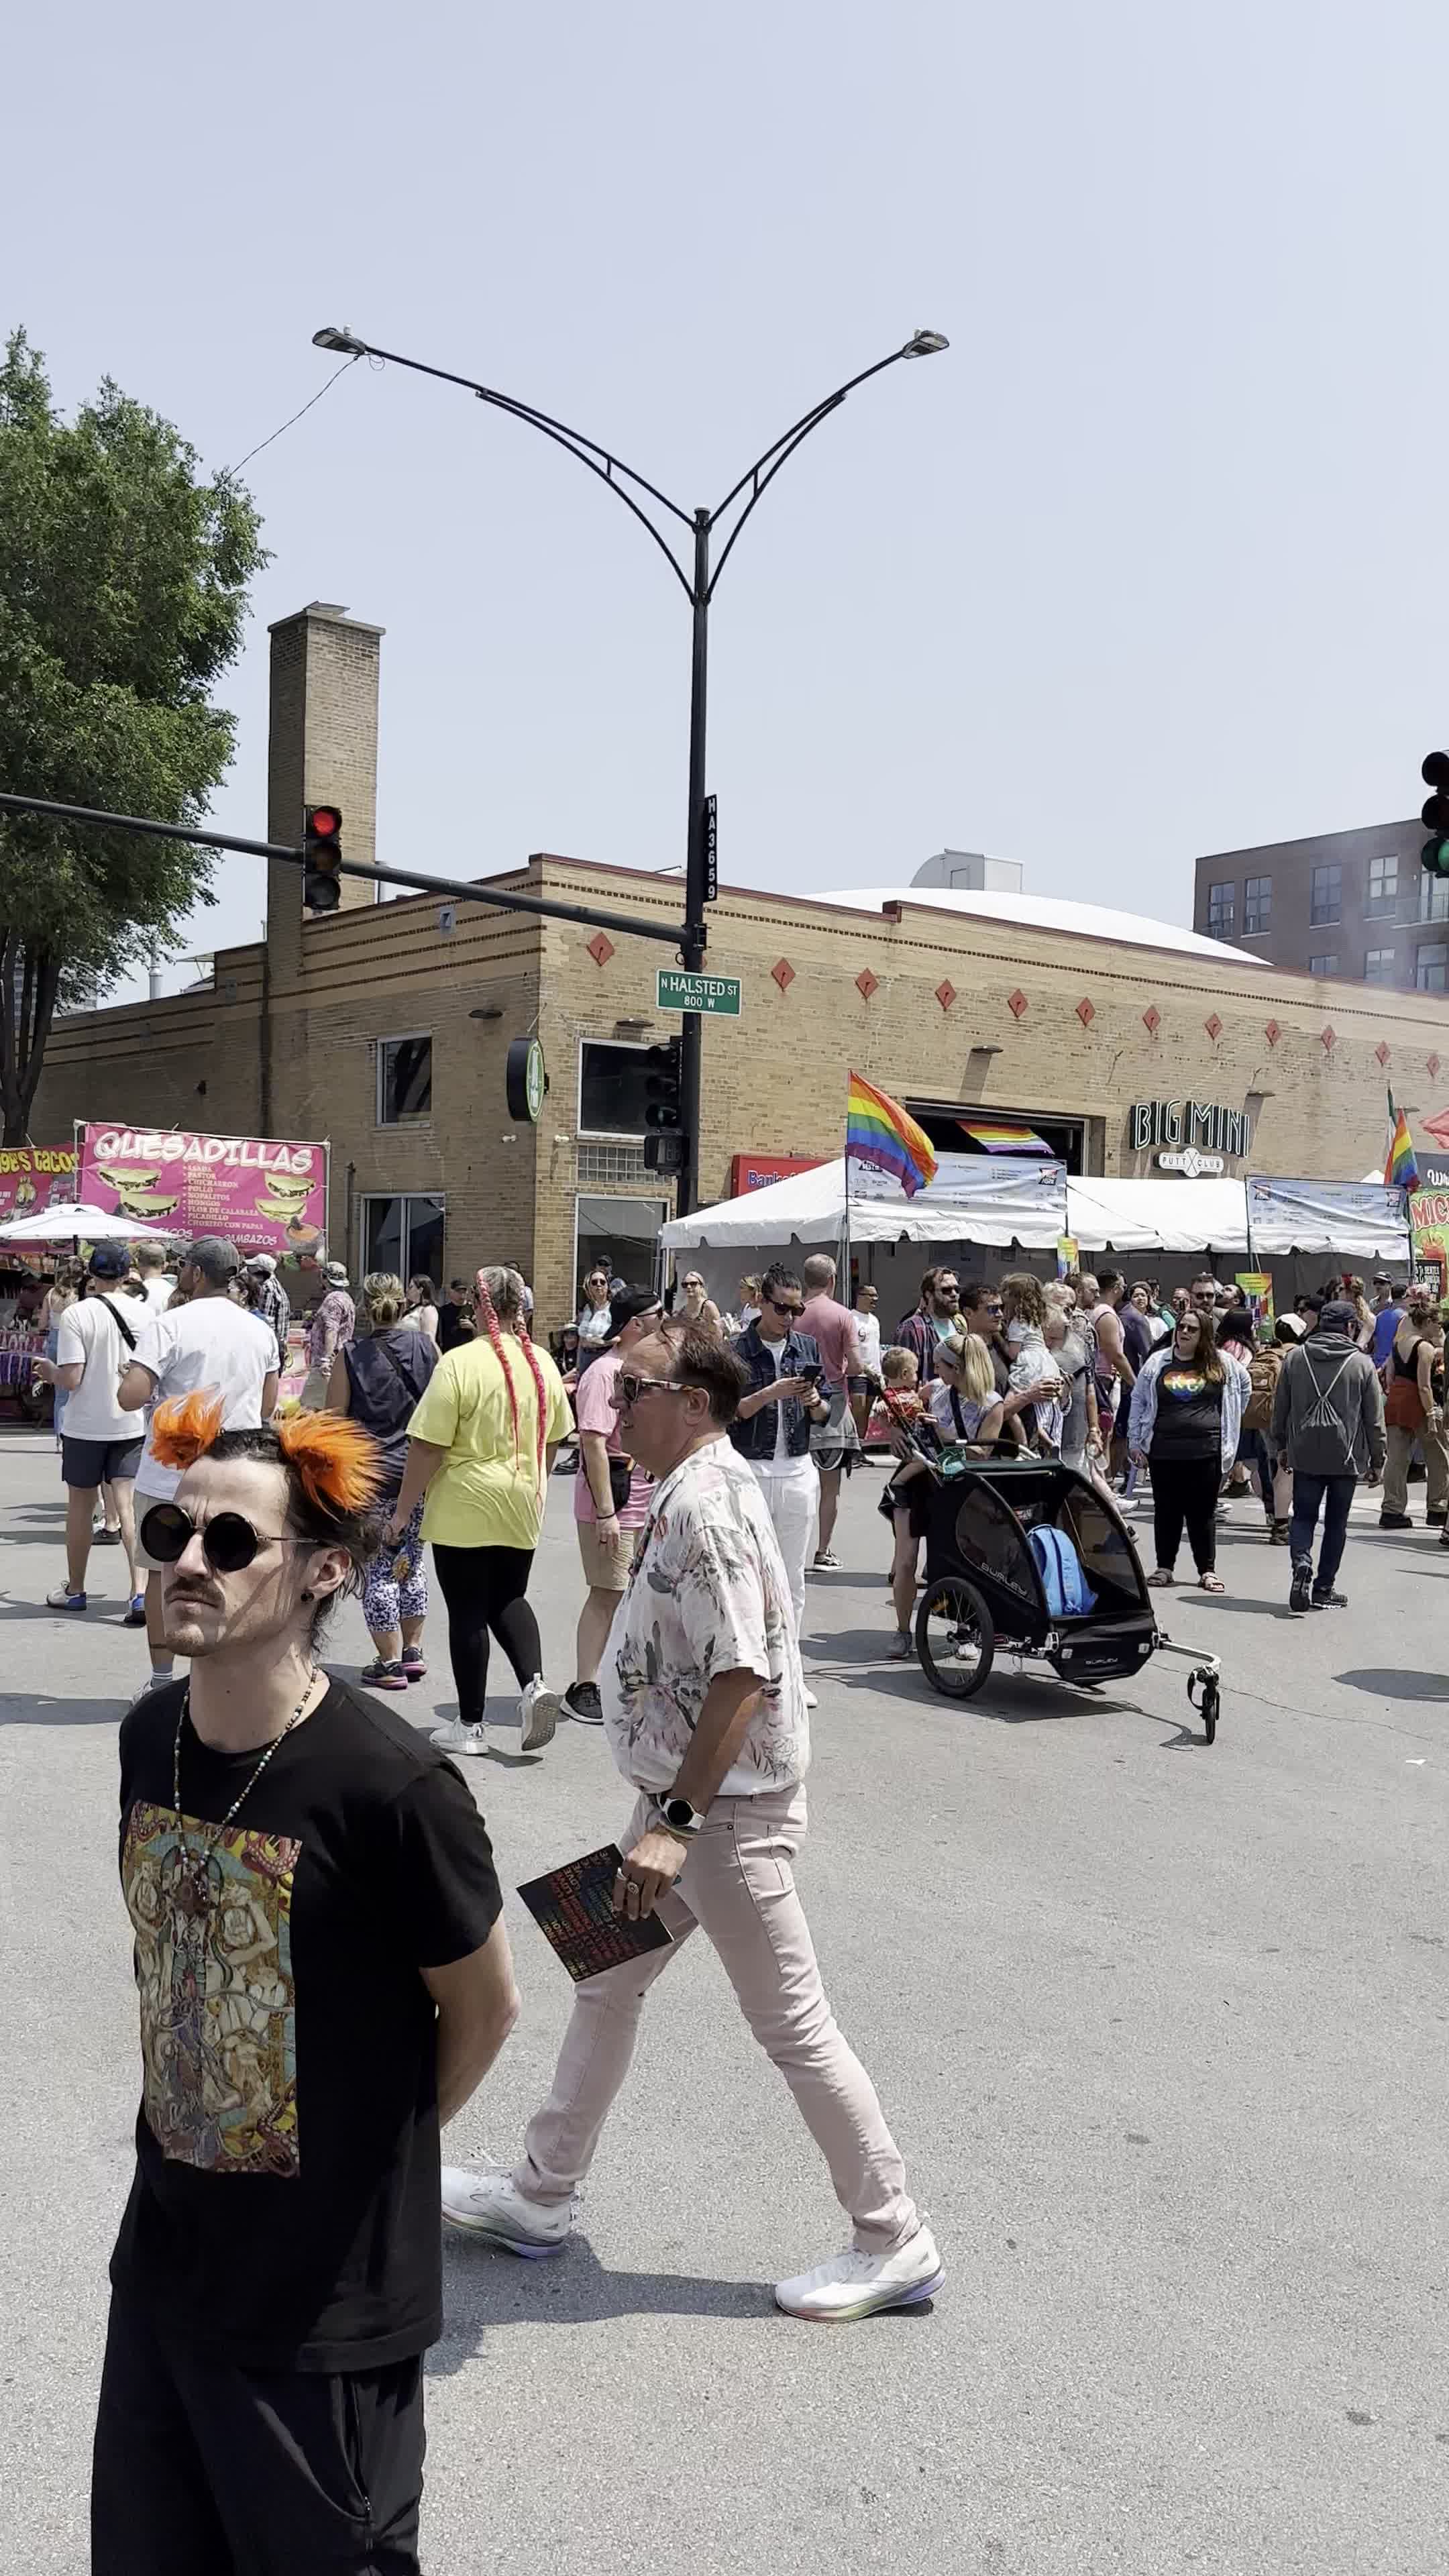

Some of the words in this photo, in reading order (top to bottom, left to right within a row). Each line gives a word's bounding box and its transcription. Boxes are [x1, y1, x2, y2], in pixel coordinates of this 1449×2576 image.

[707, 798, 716, 900] HA3659
[661, 977, 668, 988] N
[670, 976, 725, 996] HALSTED
[727, 985, 738, 996] ST
[684, 996, 702, 1007] 800
[708, 998, 715, 1008] W
[1132, 1099, 1181, 1150] BIG
[1186, 1099, 1250, 1159] MINI
[93, 1131, 313, 1174] QUESADILLAS
[1163, 1156, 1187, 1165] PUTT
[1197, 1159, 1220, 1169] CLUB
[188, 1172, 217, 1180] PASTOR
